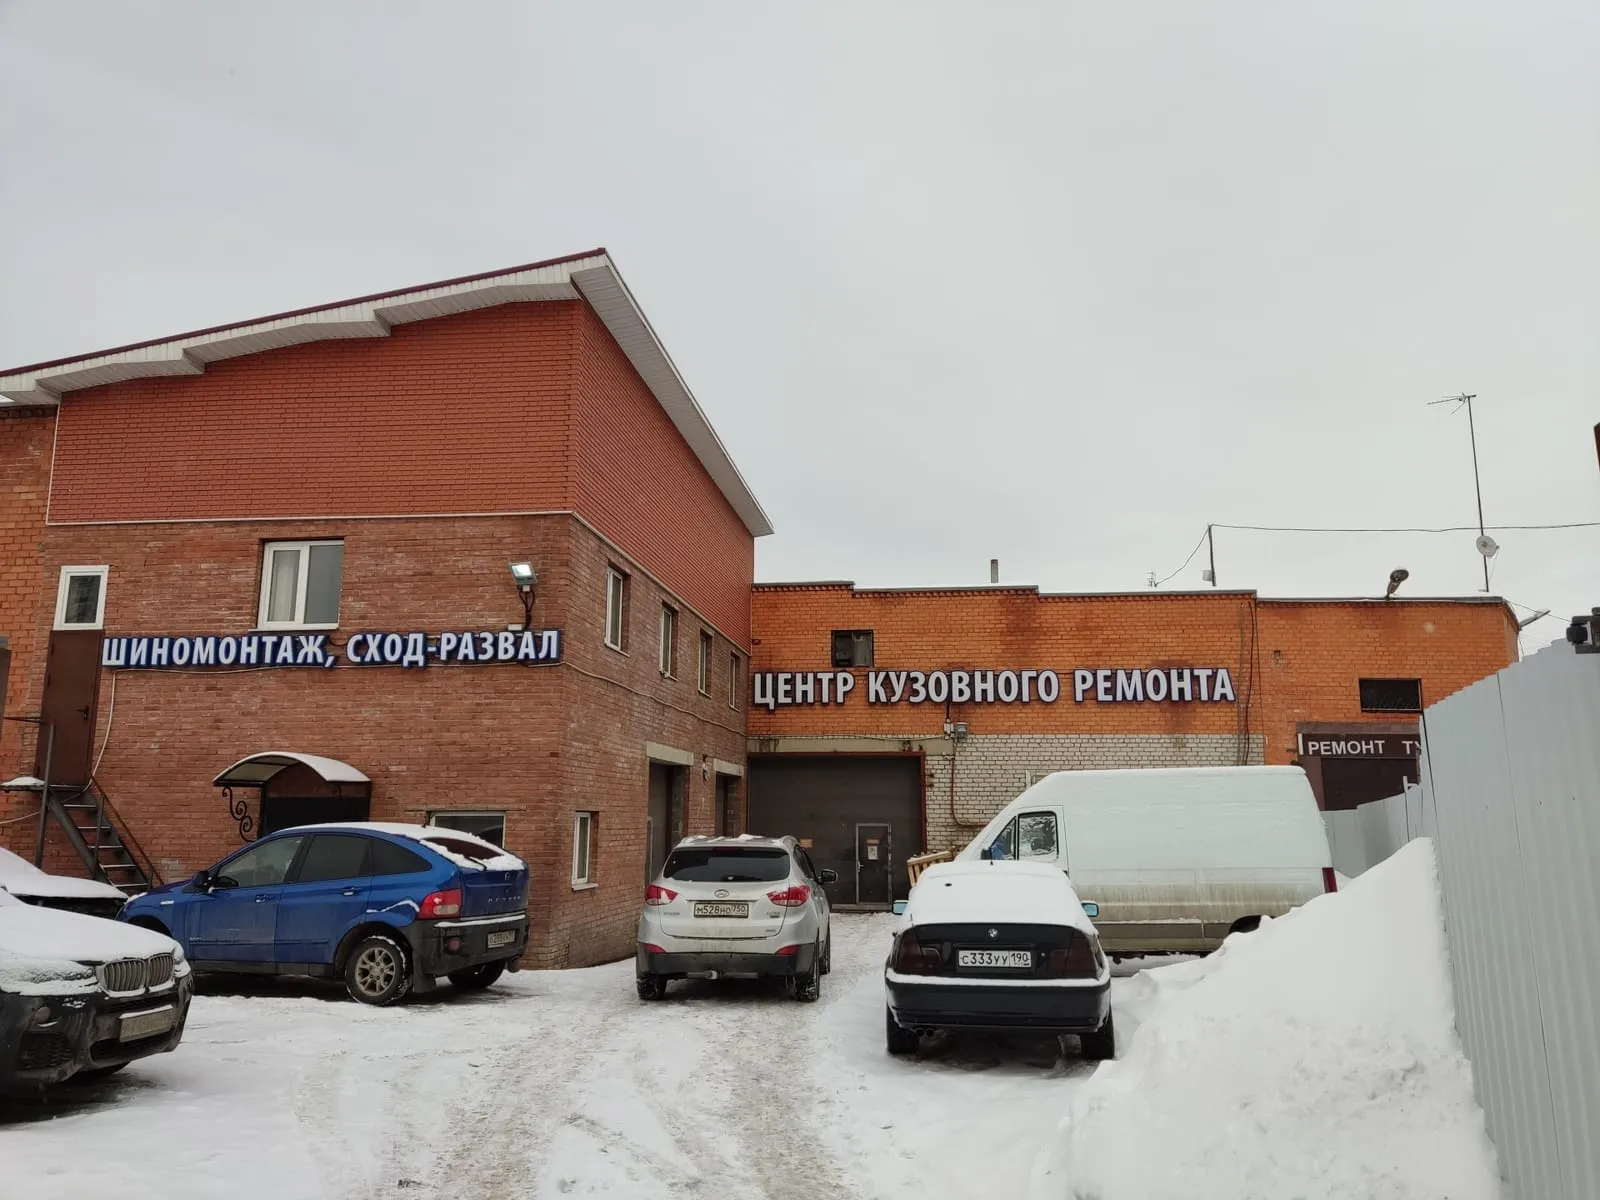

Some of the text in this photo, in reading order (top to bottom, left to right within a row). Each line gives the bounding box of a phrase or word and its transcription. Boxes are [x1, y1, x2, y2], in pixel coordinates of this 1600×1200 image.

[102, 630, 559, 667] ШИНОМОНТАЖ, СХОД-РАЗВАЛ
[753, 668, 1235, 709] ЦЕНТР КУЗОВНОГО РЕМОНТА
[1307, 740, 1385, 756] РЕМОНТ
